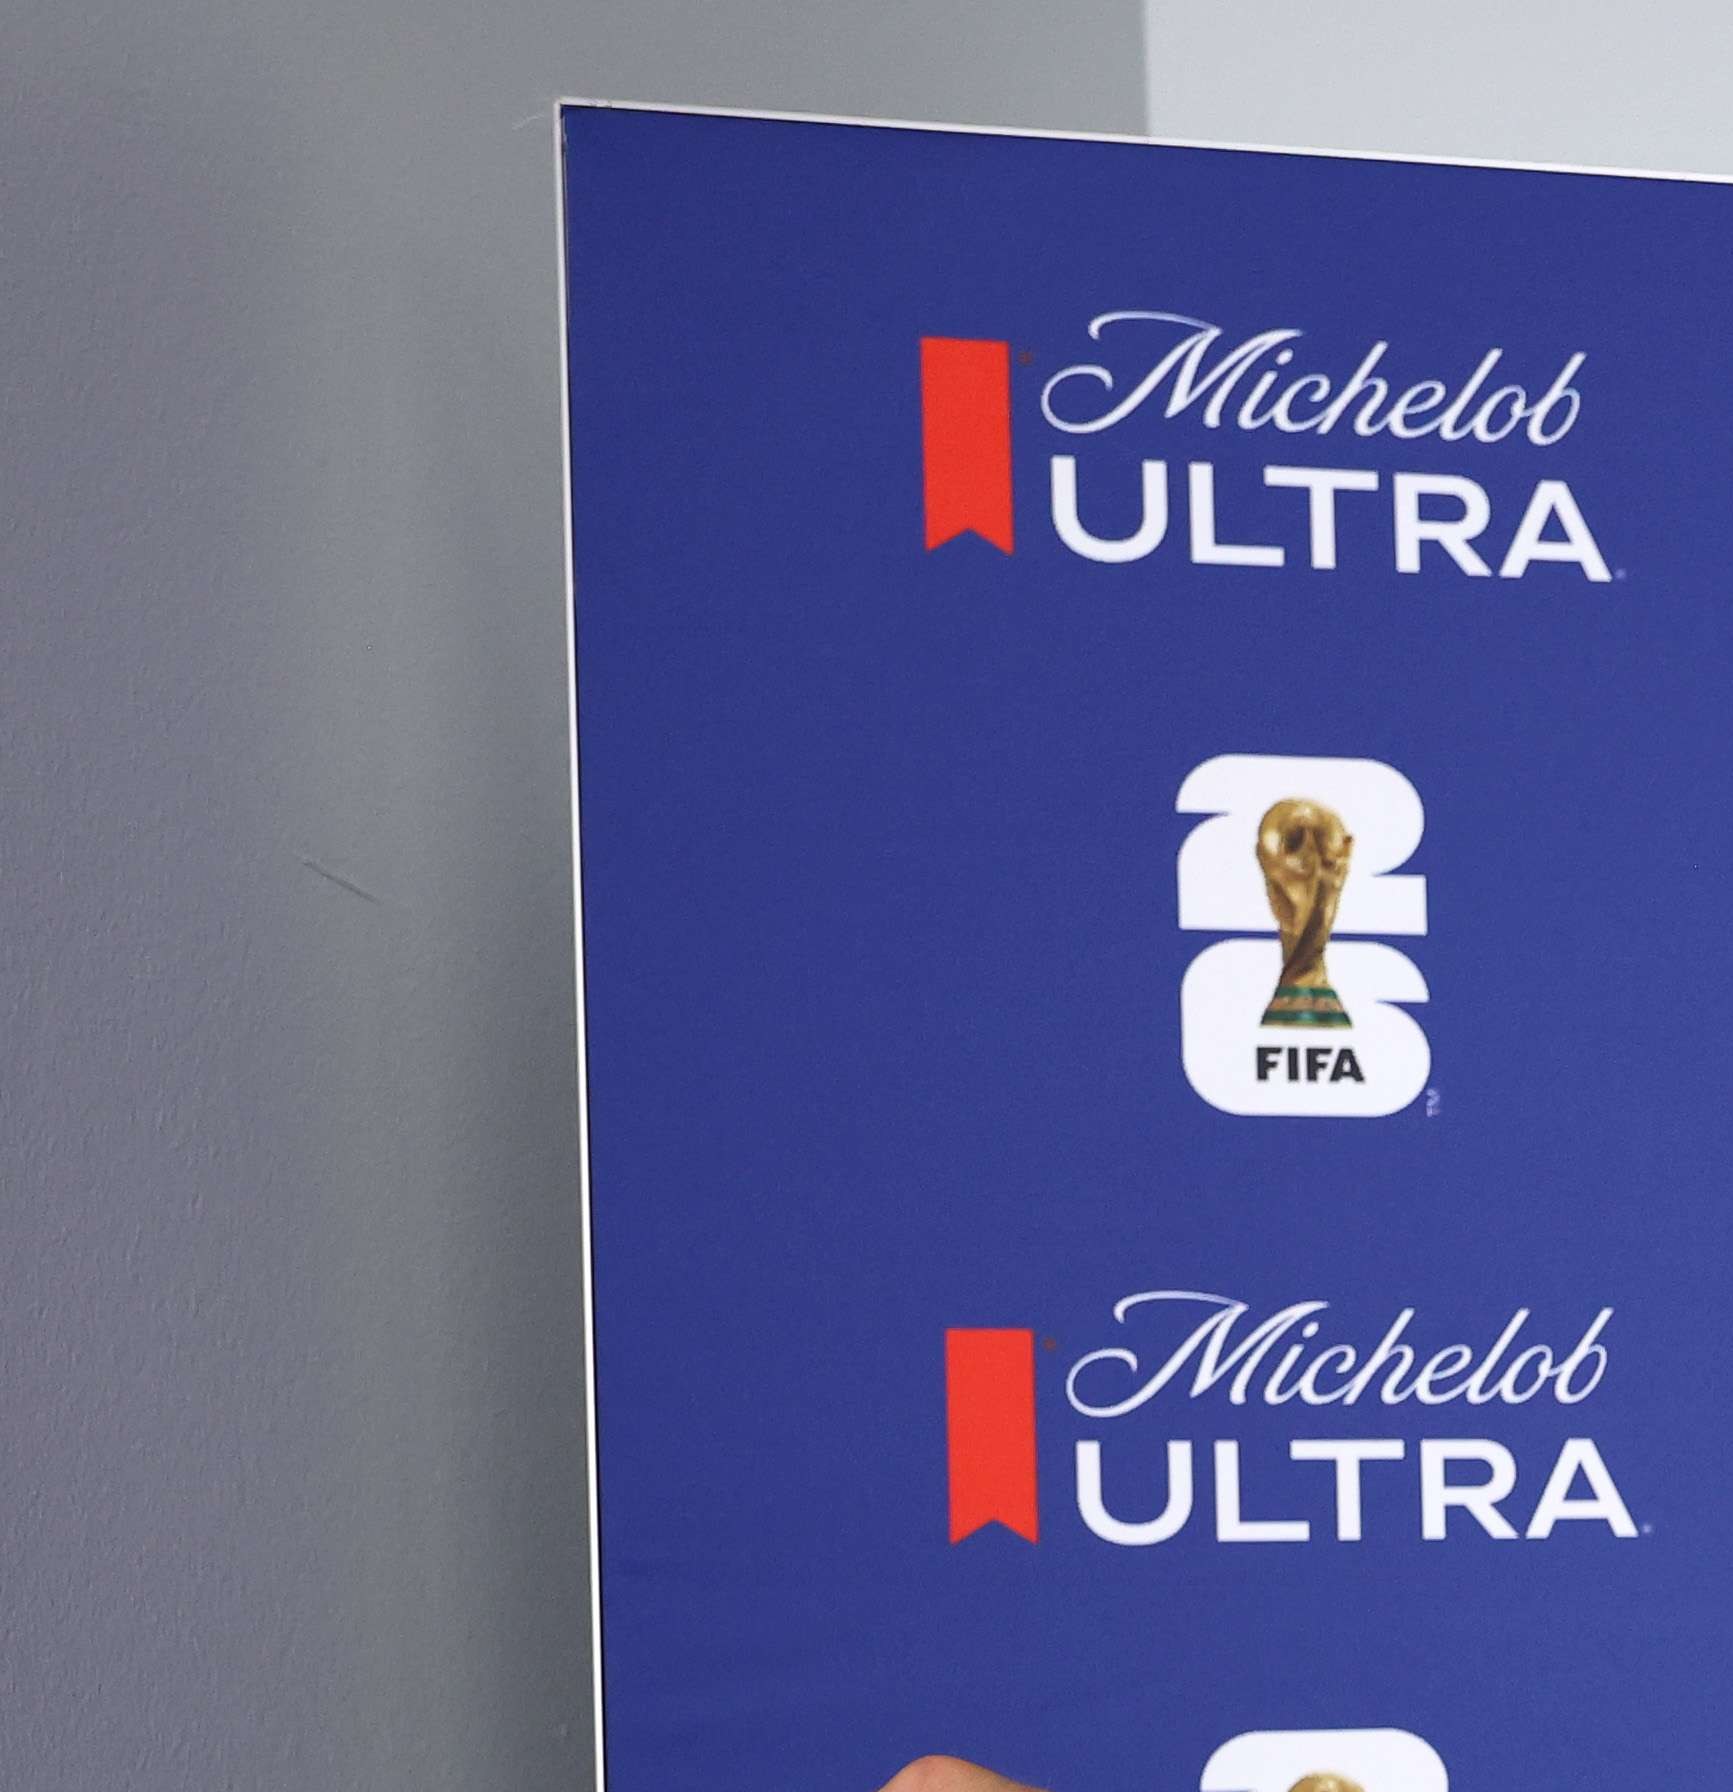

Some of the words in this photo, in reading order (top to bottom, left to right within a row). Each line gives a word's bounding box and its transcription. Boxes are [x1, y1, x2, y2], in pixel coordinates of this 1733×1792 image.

[1041, 311, 1588, 446] Michelob
[1050, 455, 1612, 583] ULTRA
[1255, 1045, 1366, 1084] FIFA
[1066, 1290, 1614, 1418] Michelob
[1076, 1438, 1638, 1546] ULTRA
